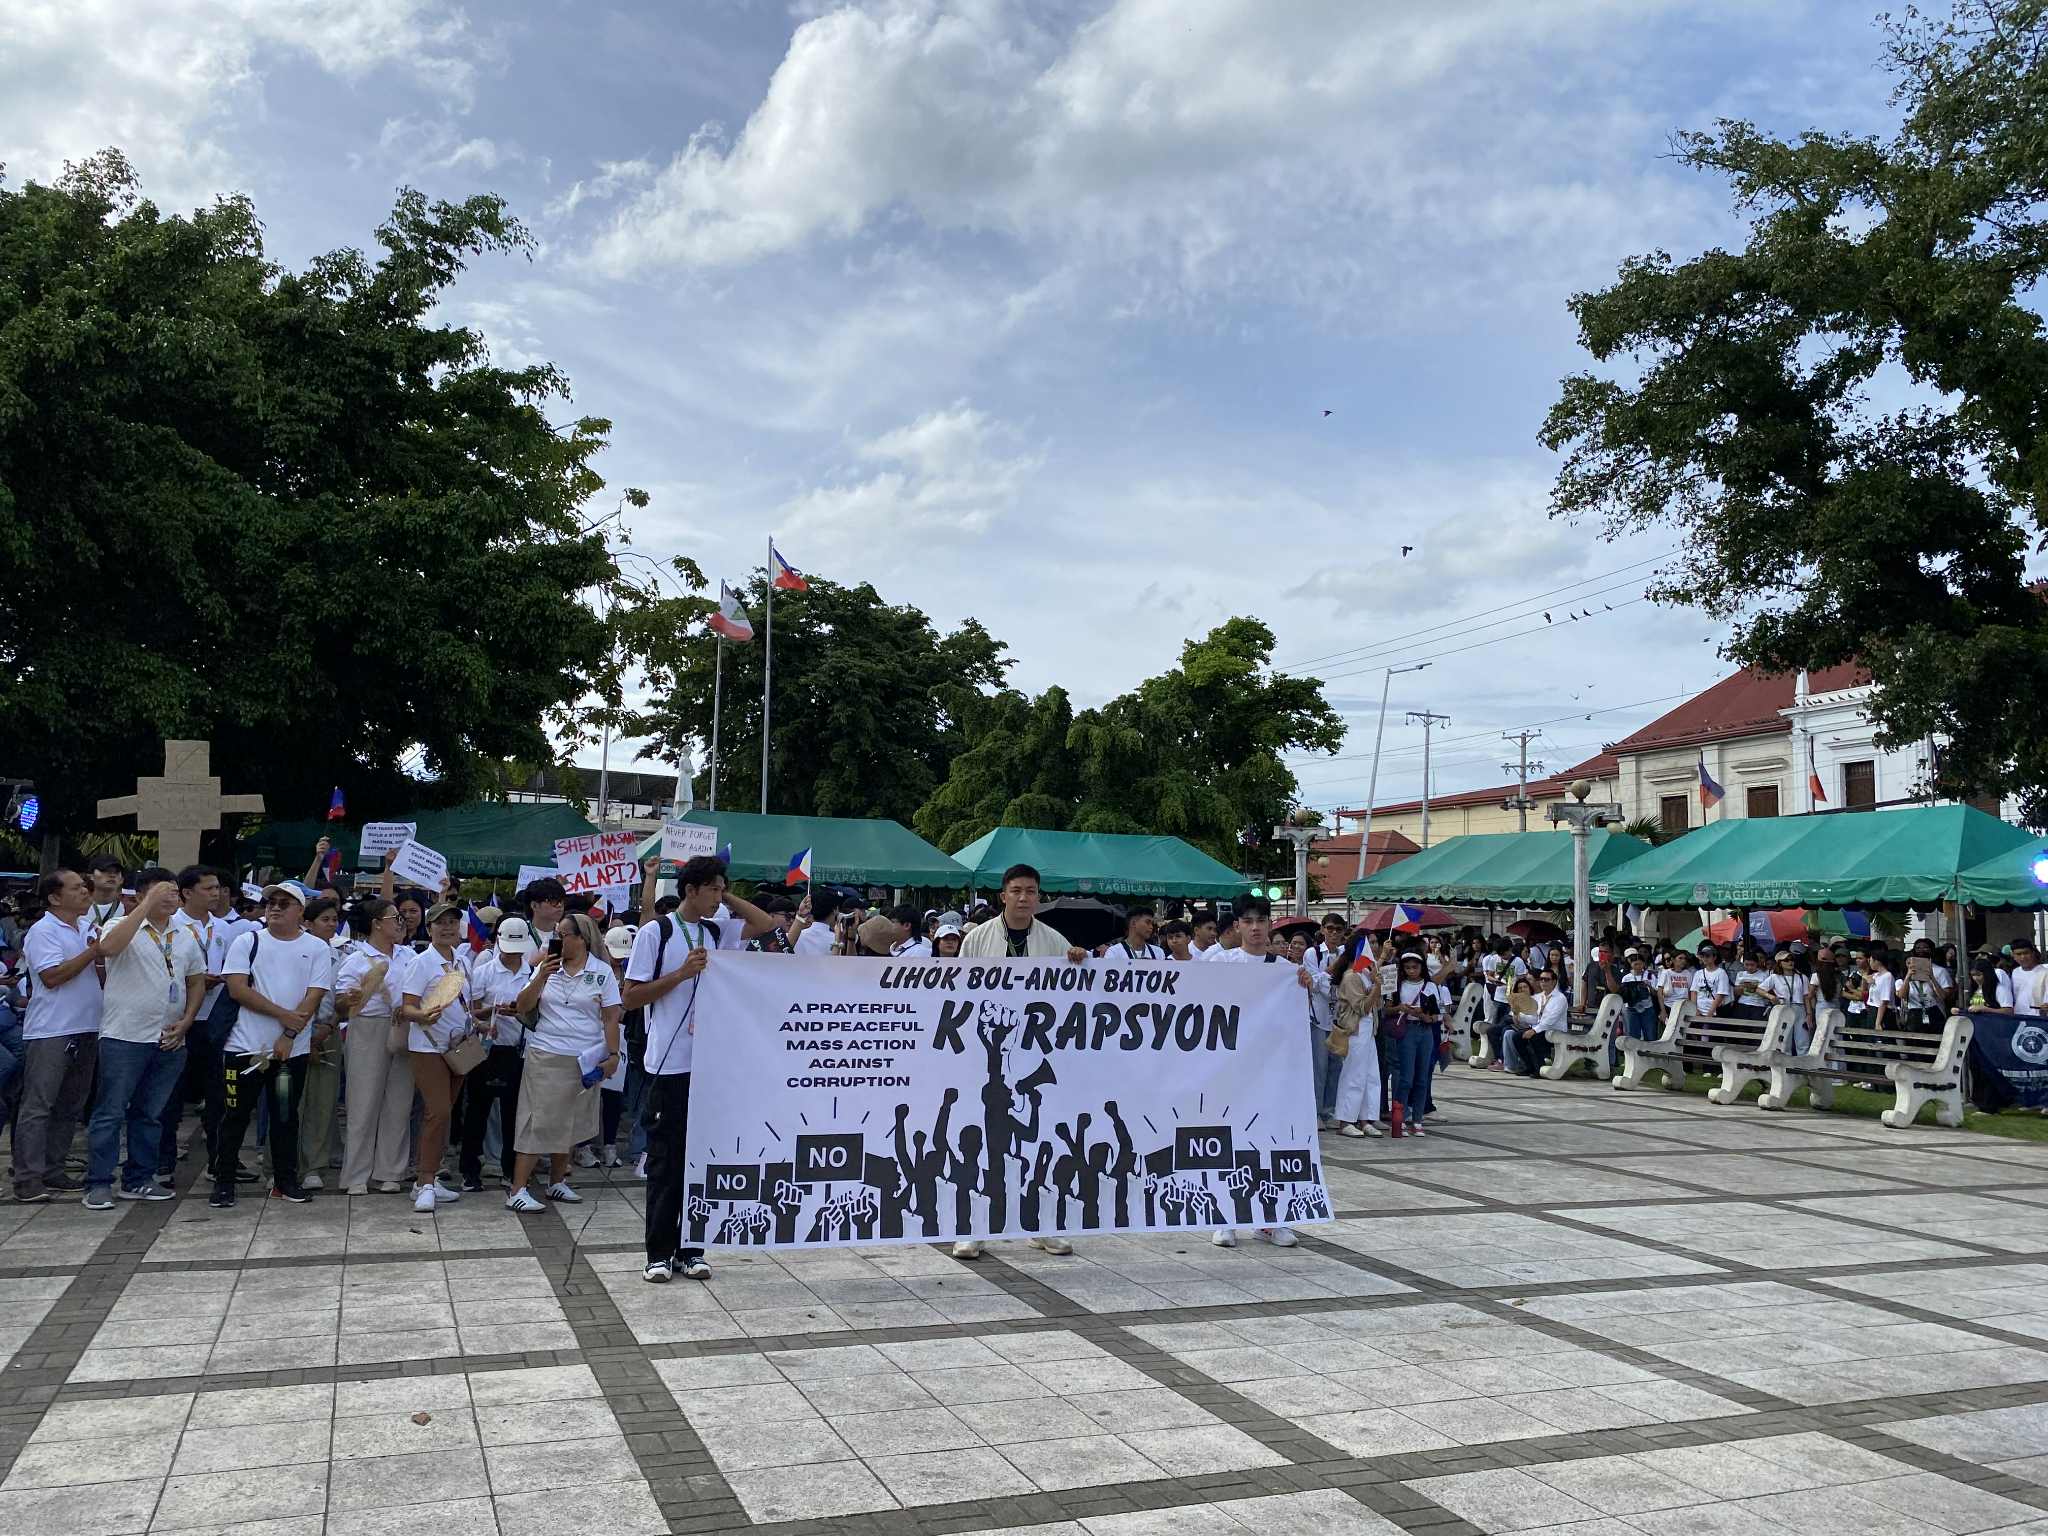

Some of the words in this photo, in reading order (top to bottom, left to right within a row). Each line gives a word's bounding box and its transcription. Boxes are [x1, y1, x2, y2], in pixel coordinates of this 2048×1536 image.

[665, 826, 687, 837] NEVER
[689, 830, 716, 841] FORGET
[556, 836, 595, 857] SHET
[581, 846, 626, 869] AMING
[1716, 888, 1799, 900] TAGBILARAN
[880, 966, 961, 991] LIHOK
[967, 967, 1097, 992] BOL-ANON
[1103, 969, 1181, 995] BATOK
[787, 1003, 804, 1014] A
[806, 1003, 917, 1014] PRAYERFUL
[778, 1021, 824, 1032] AND
[827, 1021, 925, 1032] PEACEFUL
[786, 1040, 844, 1051] MASS
[846, 1039, 916, 1050] ACTION
[808, 1058, 895, 1069] AGAINST
[786, 1076, 911, 1088] CORRUPTION
[1189, 1137, 1222, 1158] NO
[808, 1146, 848, 1169] NO
[1279, 1158, 1303, 1173] NO
[716, 1174, 747, 1190] NO
